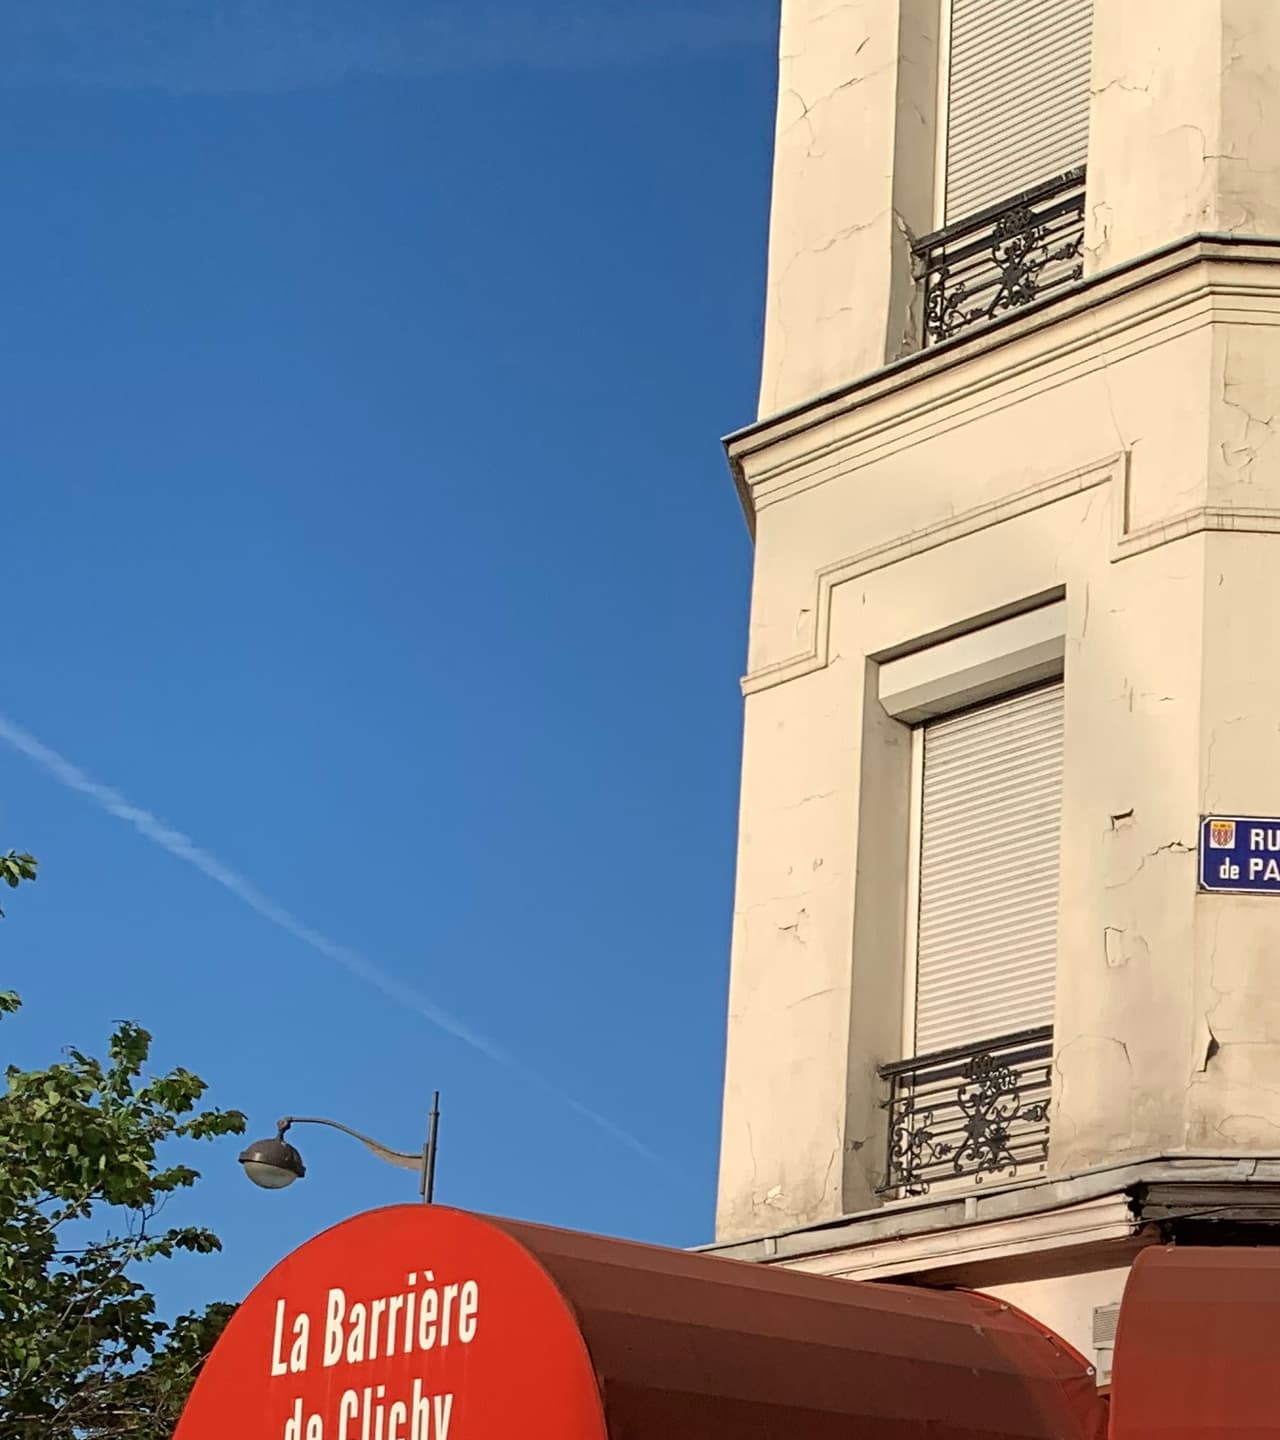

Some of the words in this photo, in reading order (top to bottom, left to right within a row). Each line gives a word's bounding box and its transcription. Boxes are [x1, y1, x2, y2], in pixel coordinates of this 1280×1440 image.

[1219, 857, 1240, 879] de
[271, 1299, 310, 1377] La
[323, 1270, 479, 1367] Barrière
